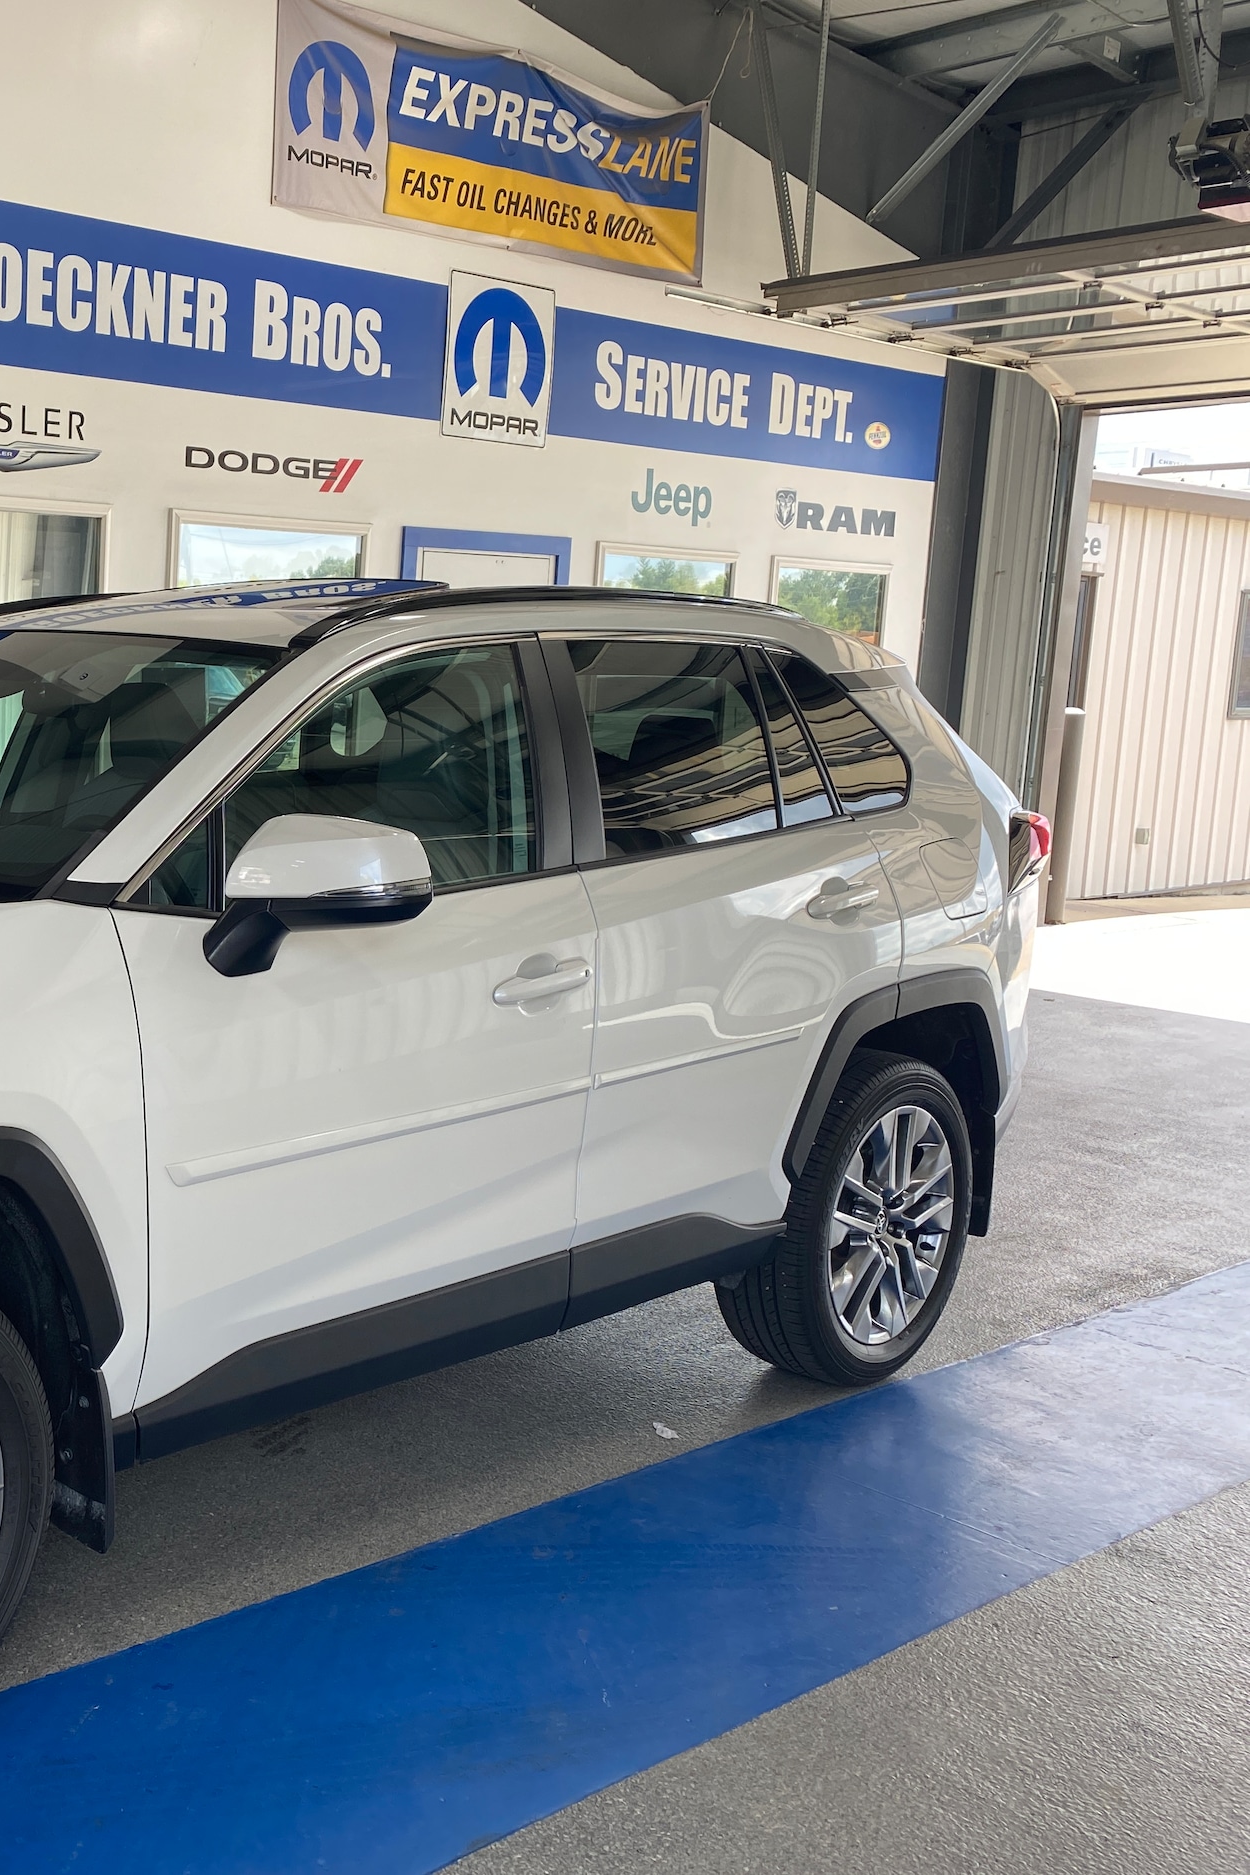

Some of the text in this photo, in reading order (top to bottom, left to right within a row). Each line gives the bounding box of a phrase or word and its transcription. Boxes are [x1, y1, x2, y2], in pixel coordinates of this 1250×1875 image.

[286, 144, 373, 180] MOPAR
[400, 168, 455, 201] FAST
[456, 181, 487, 213] OIL
[493, 187, 581, 232] CHANGES
[584, 214, 599, 236] &
[252, 278, 392, 378] BROS.
[594, 340, 853, 444] SERVICE DEPT.
[449, 407, 540, 437] MOPAR
[184, 445, 341, 482] DODGE
[631, 468, 712, 527] Jeep
[796, 501, 897, 538] RAM
